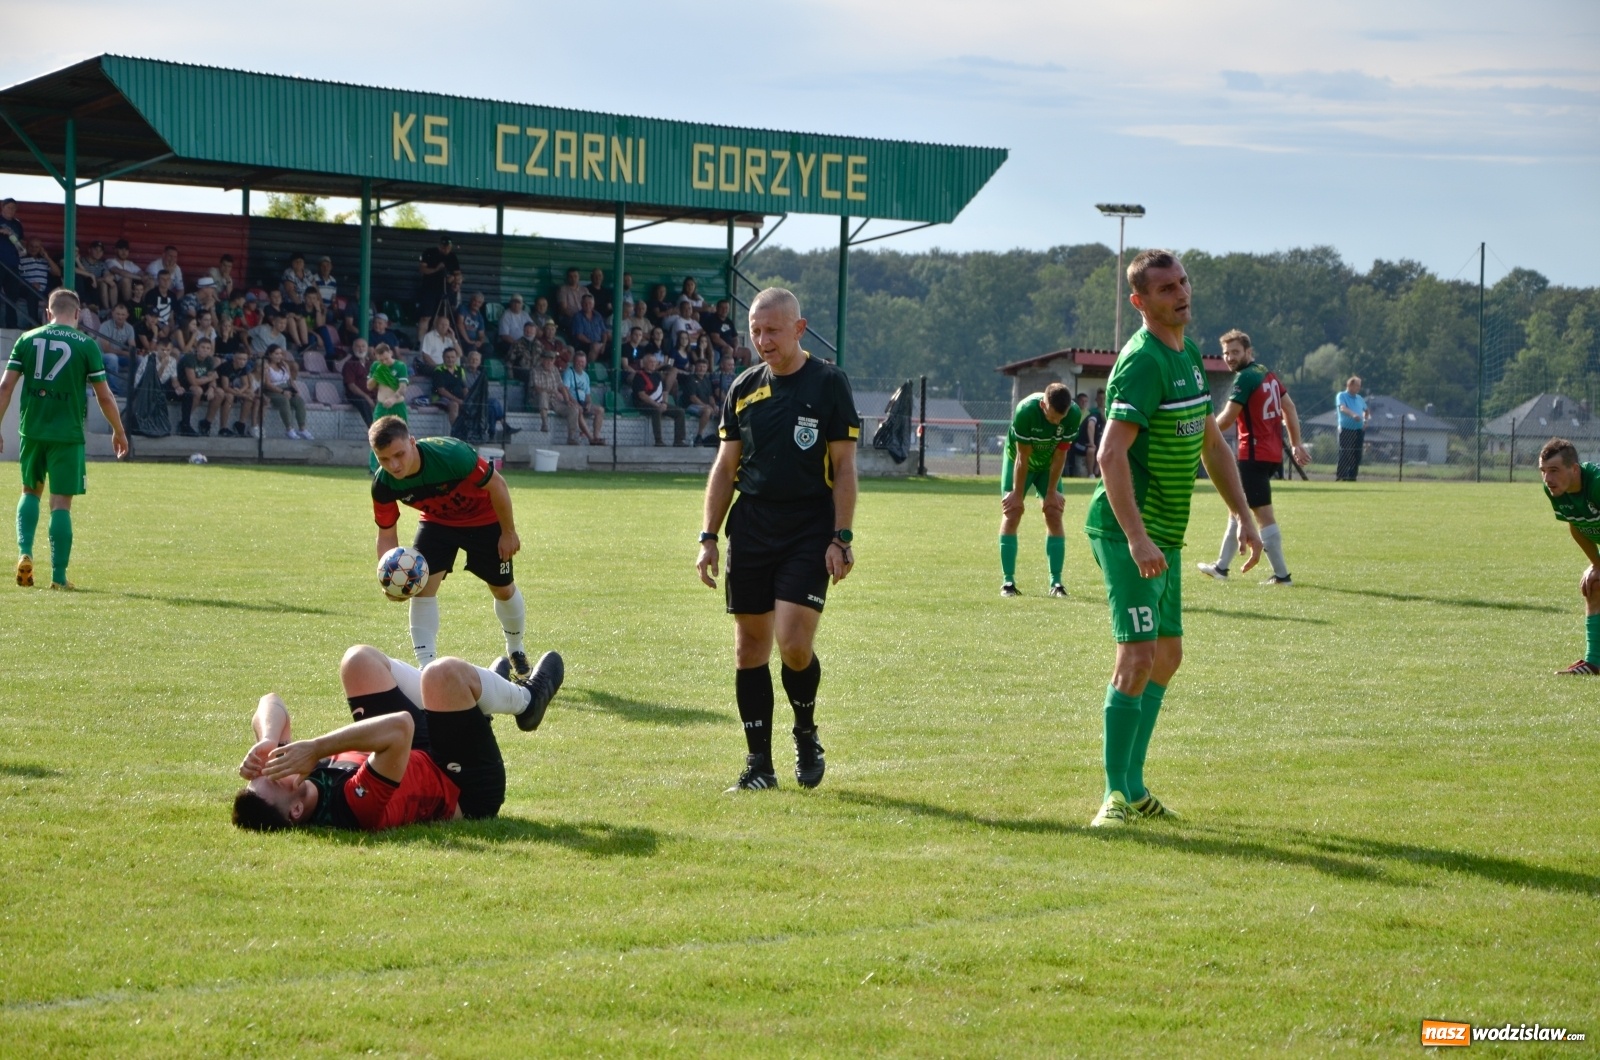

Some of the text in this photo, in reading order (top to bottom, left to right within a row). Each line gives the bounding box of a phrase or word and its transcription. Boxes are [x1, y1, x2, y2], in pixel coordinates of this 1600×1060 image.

[392, 111, 868, 200] KS CZARNI GORZYCE
[33, 338, 72, 381] 17
[1262, 379, 1281, 420] 20
[500, 561, 510, 575] 23
[1127, 605, 1154, 633] 13
